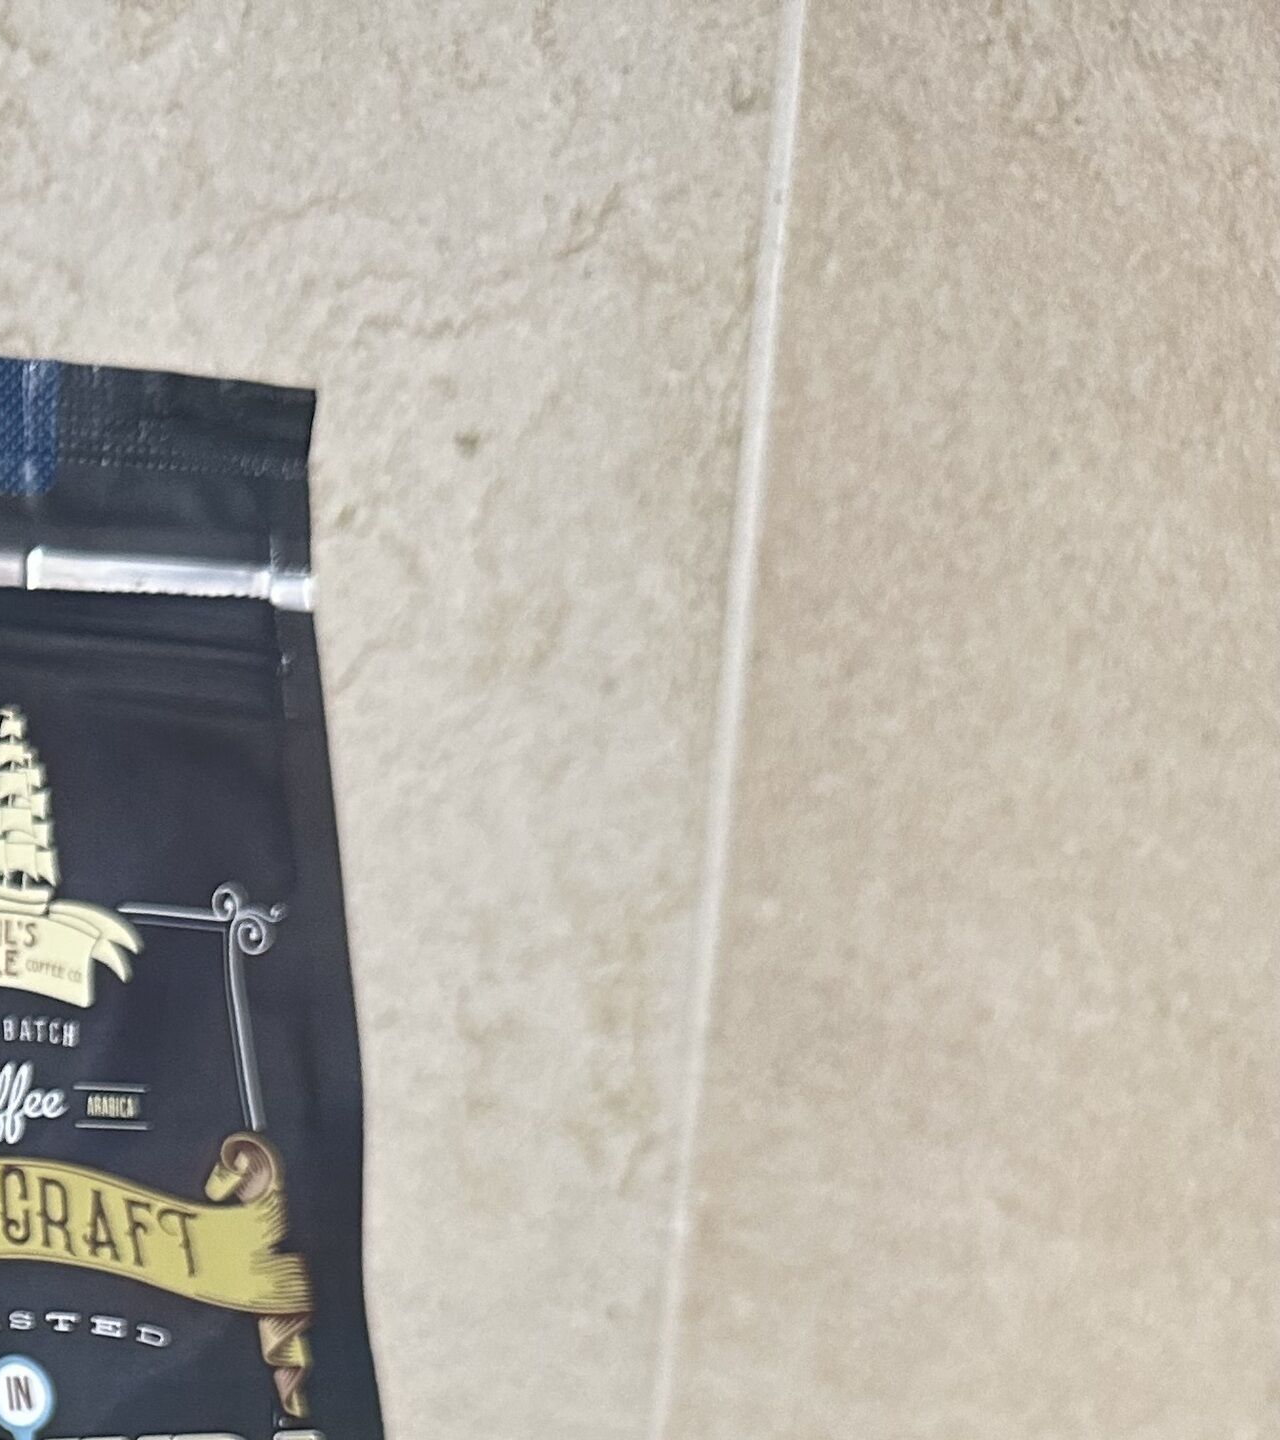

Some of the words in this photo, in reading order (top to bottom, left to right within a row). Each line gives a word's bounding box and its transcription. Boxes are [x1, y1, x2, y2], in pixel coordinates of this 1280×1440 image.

[26, 959, 65, 980] COFFEE
[2, 1016, 81, 1048] BATCH
[86, 1093, 138, 1119] ARABICA
[4, 1374, 35, 1412] IN
